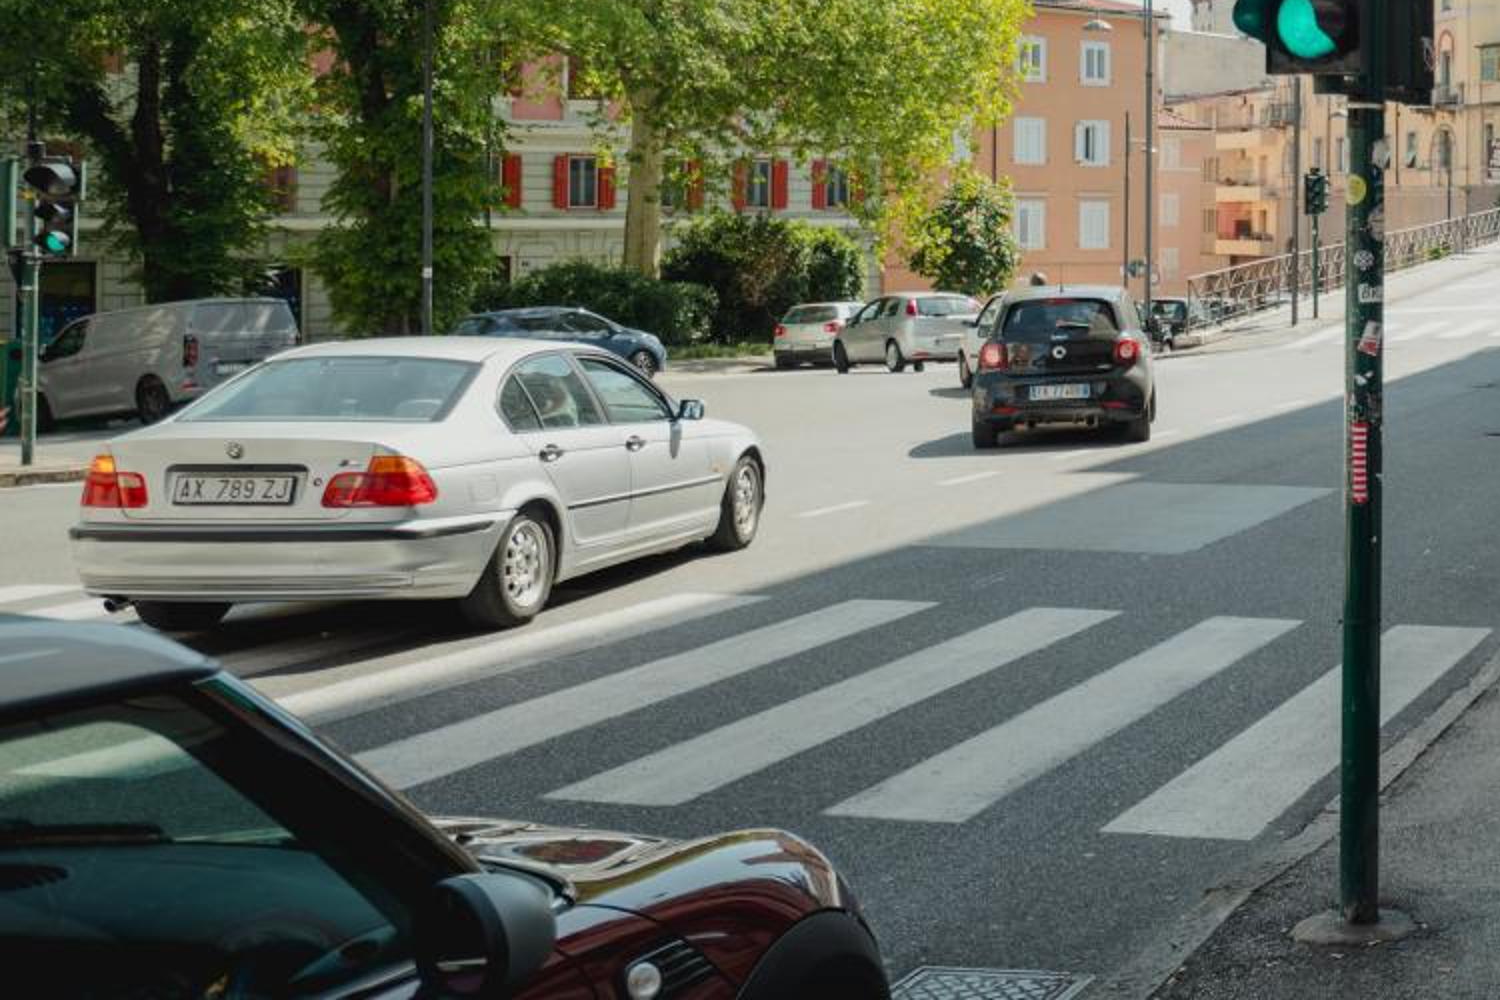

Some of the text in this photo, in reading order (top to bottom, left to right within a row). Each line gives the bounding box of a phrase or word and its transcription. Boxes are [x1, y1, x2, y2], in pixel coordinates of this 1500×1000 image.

[181, 480, 289, 499] AX 789 ZJ
